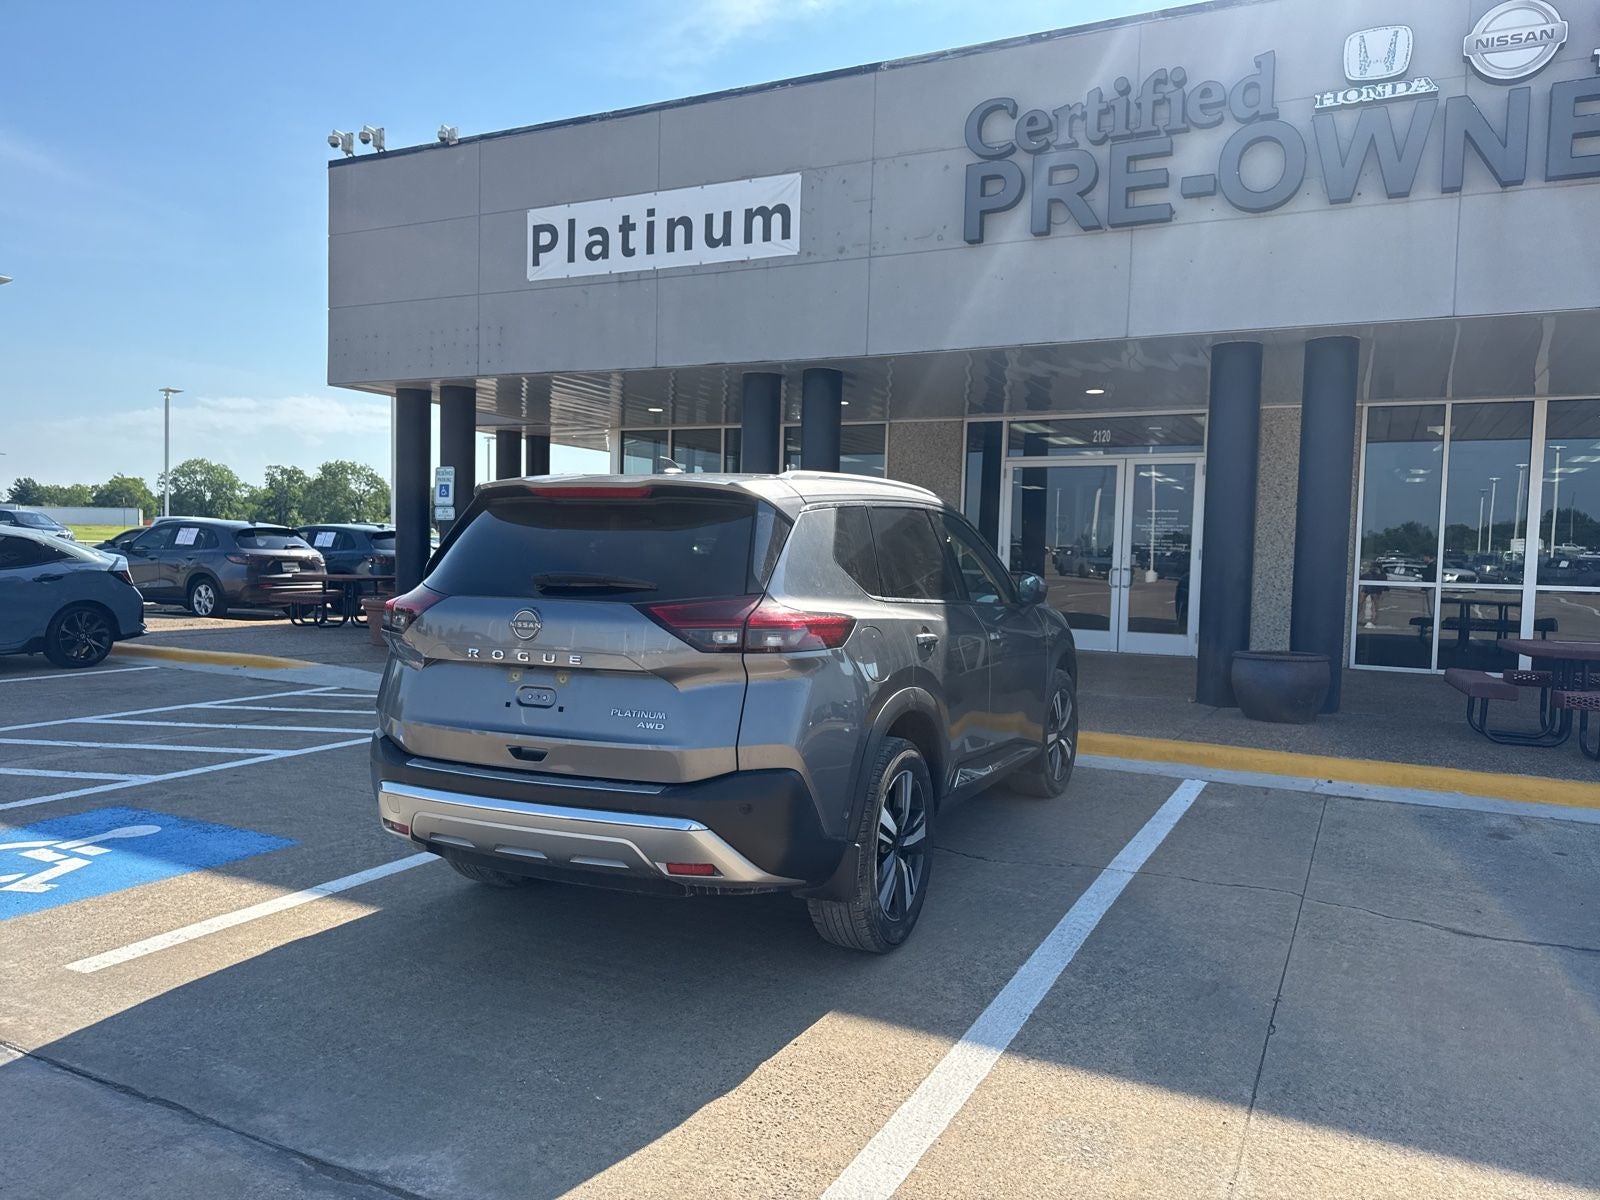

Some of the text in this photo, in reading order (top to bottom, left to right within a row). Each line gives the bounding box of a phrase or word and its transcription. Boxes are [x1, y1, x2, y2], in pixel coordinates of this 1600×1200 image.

[1475, 28, 1555, 50] NISSAN
[1314, 76, 1440, 108] HONDA
[965, 50, 1279, 160] Certified
[531, 202, 792, 268] Platinum
[1092, 429, 1111, 444] 2120
[509, 621, 541, 629] NISSAN
[467, 647, 583, 665] ROGUE
[610, 708, 666, 720] PLATINUM
[637, 721, 665, 730] AWD
